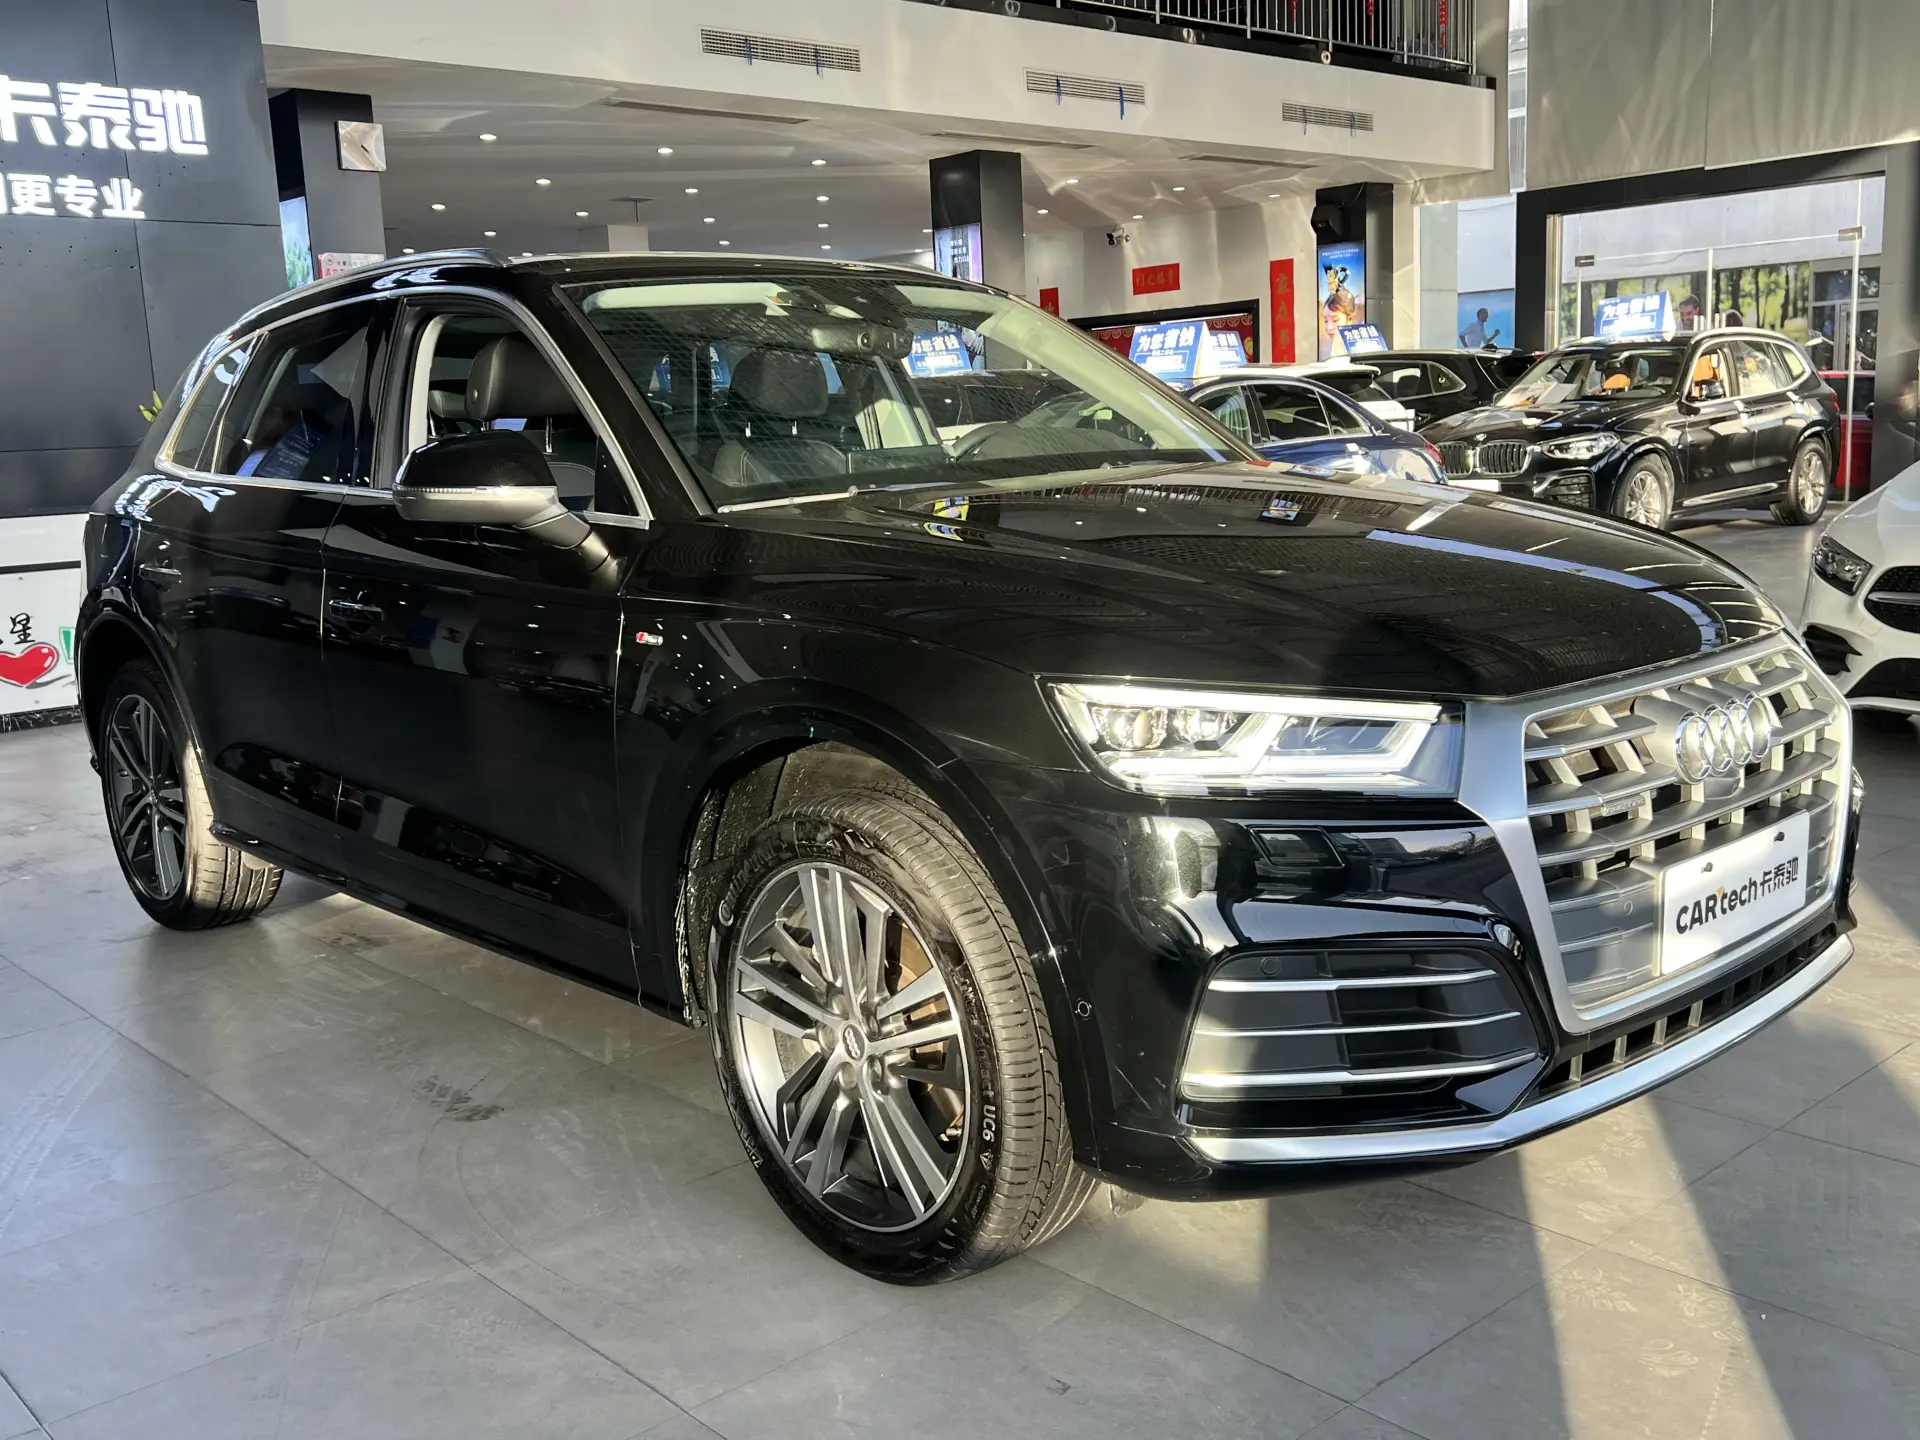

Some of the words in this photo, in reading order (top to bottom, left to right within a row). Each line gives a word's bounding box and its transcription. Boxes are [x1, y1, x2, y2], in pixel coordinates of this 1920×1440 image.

[0, 74, 209, 155] 卡泰驰
[0, 171, 146, 218] 更专业
[911, 334, 960, 354] 为您省钱
[1137, 326, 1196, 353] 为您省钱
[0, 612, 36, 645] 星
[1676, 877, 1758, 935] CARtech
[1760, 856, 1799, 897] 卡泰驰
[982, 1104, 996, 1142] UC6
